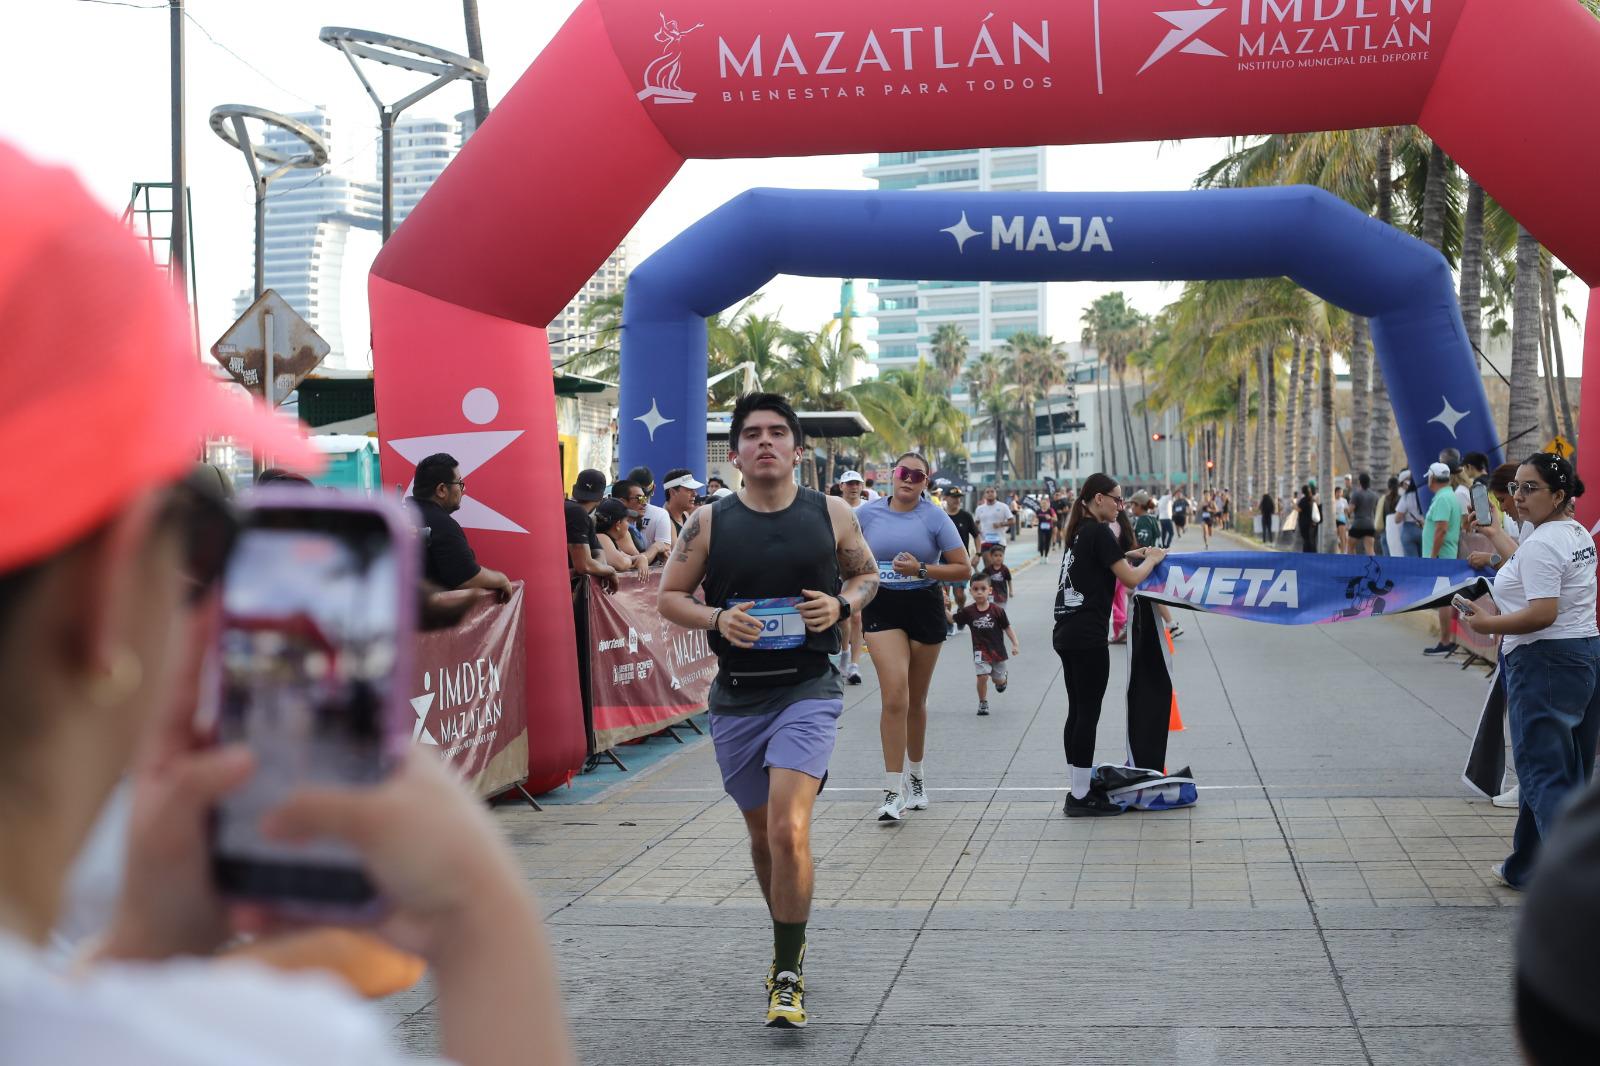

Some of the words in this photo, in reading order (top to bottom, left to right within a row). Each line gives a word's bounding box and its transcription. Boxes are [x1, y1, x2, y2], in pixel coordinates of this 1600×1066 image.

[718, 12, 1051, 79] MAZATLÁN
[1238, 17, 1431, 58] MAZATLÁN
[1238, 59, 1295, 71] INSTITUTO
[1298, 57, 1356, 68] MUNICIPAL
[1360, 55, 1378, 64] DEL
[1382, 51, 1429, 63] DEPORTE
[722, 86, 866, 102] BIENESTAR
[884, 82, 948, 96] PARA
[966, 77, 1053, 92] TODOS
[1165, 565, 1299, 609] META
[673, 629, 714, 668] MAZATL
